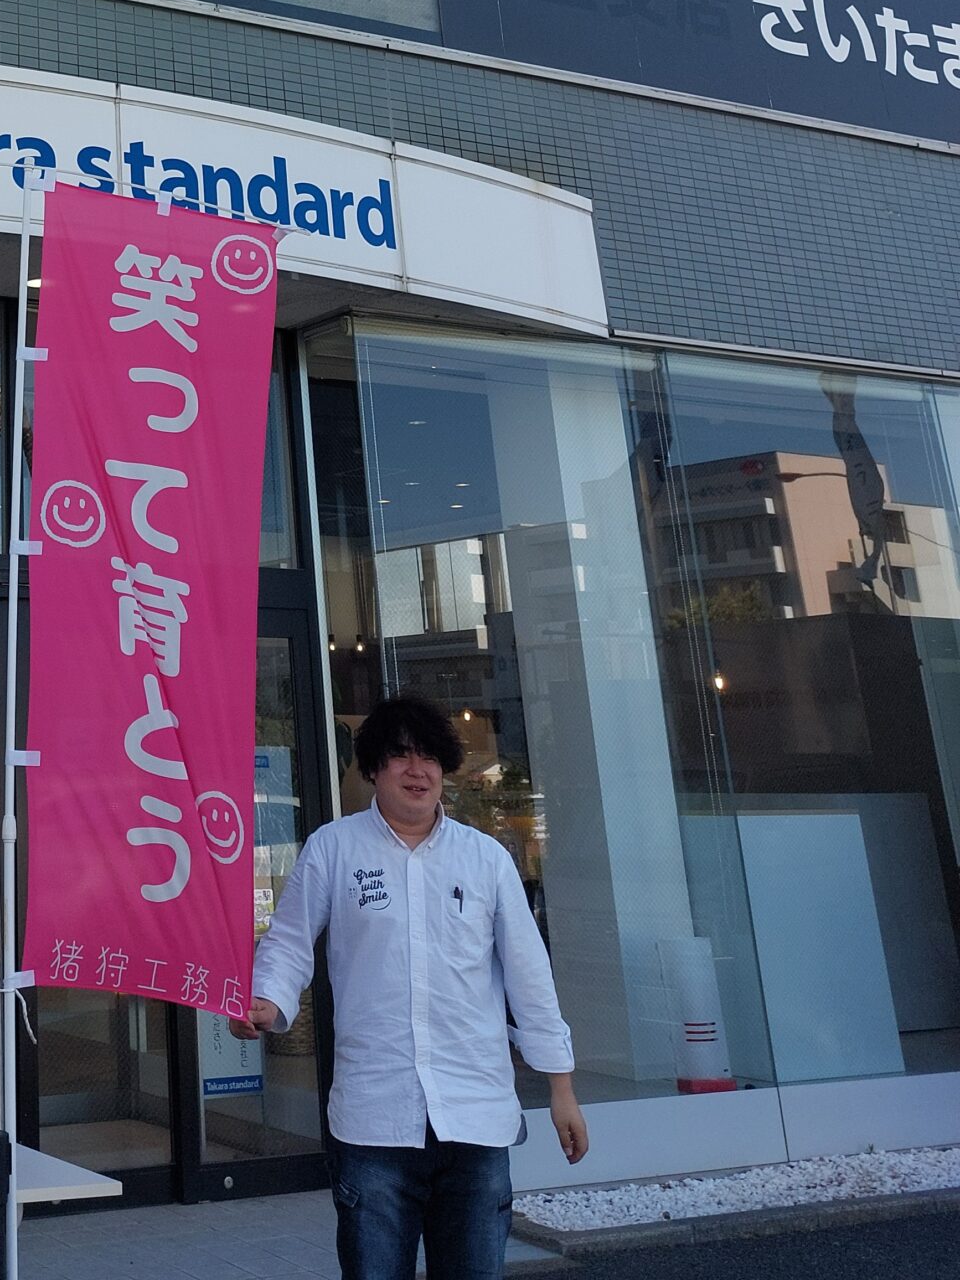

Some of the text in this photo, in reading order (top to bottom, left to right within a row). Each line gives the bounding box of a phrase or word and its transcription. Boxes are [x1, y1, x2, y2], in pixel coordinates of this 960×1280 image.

[76, 141, 397, 249] standard
[104, 243, 205, 903] 笑って育とう
[353, 868, 385, 885] Grow
[361, 879, 385, 892] with
[358, 891, 389, 909] Smile
[49, 938, 244, 1018] 猪狩工務店
[205, 1078, 259, 1091] Takara standard
